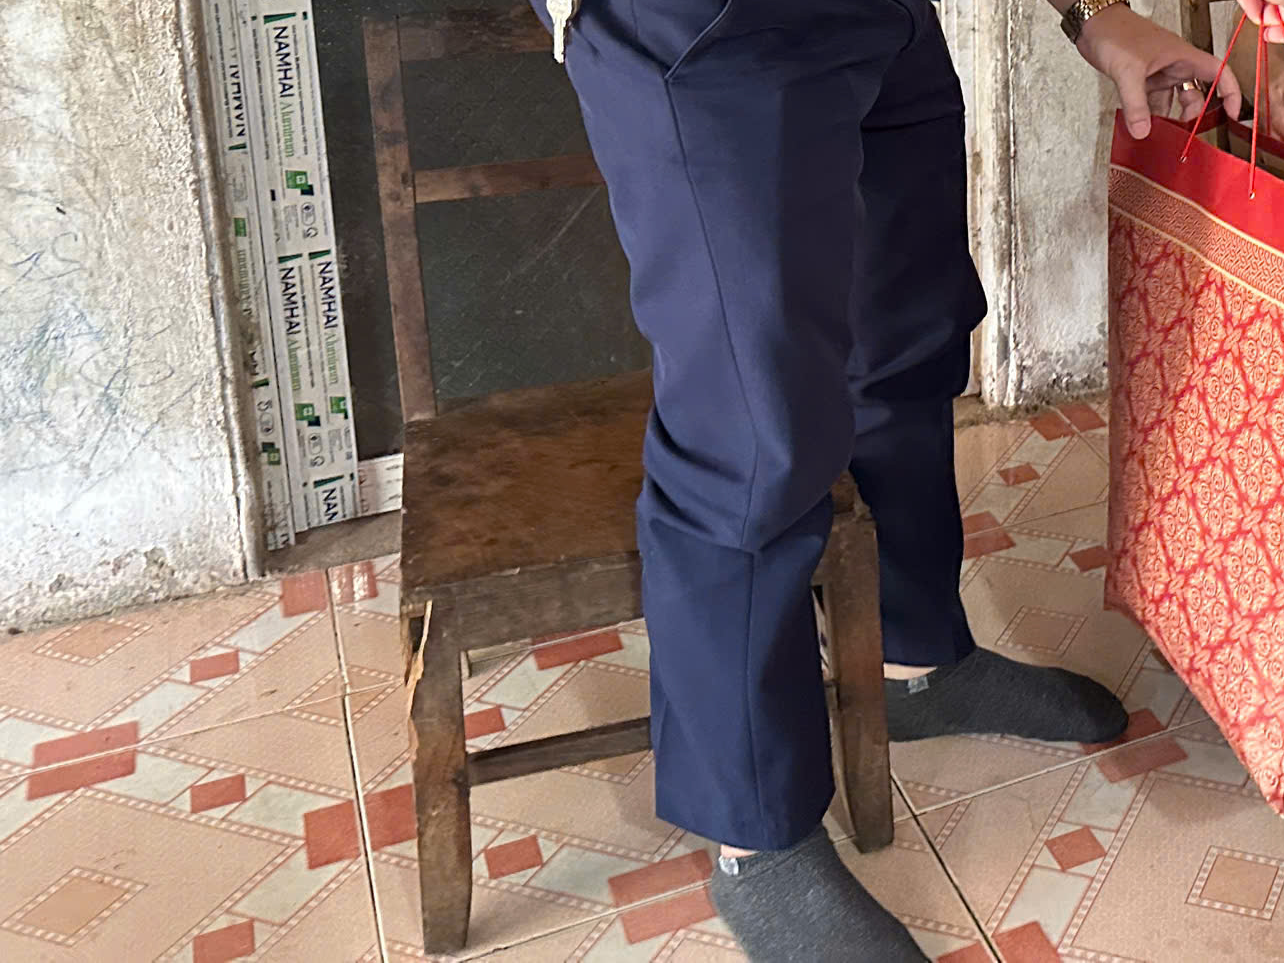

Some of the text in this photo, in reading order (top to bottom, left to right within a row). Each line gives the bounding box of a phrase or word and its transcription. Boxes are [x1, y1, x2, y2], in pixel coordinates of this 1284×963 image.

[273, 25, 295, 157] NAMHAI Aluminum
[279, 266, 301, 336] NAMHAI
[316, 261, 338, 329] NAMHAI
